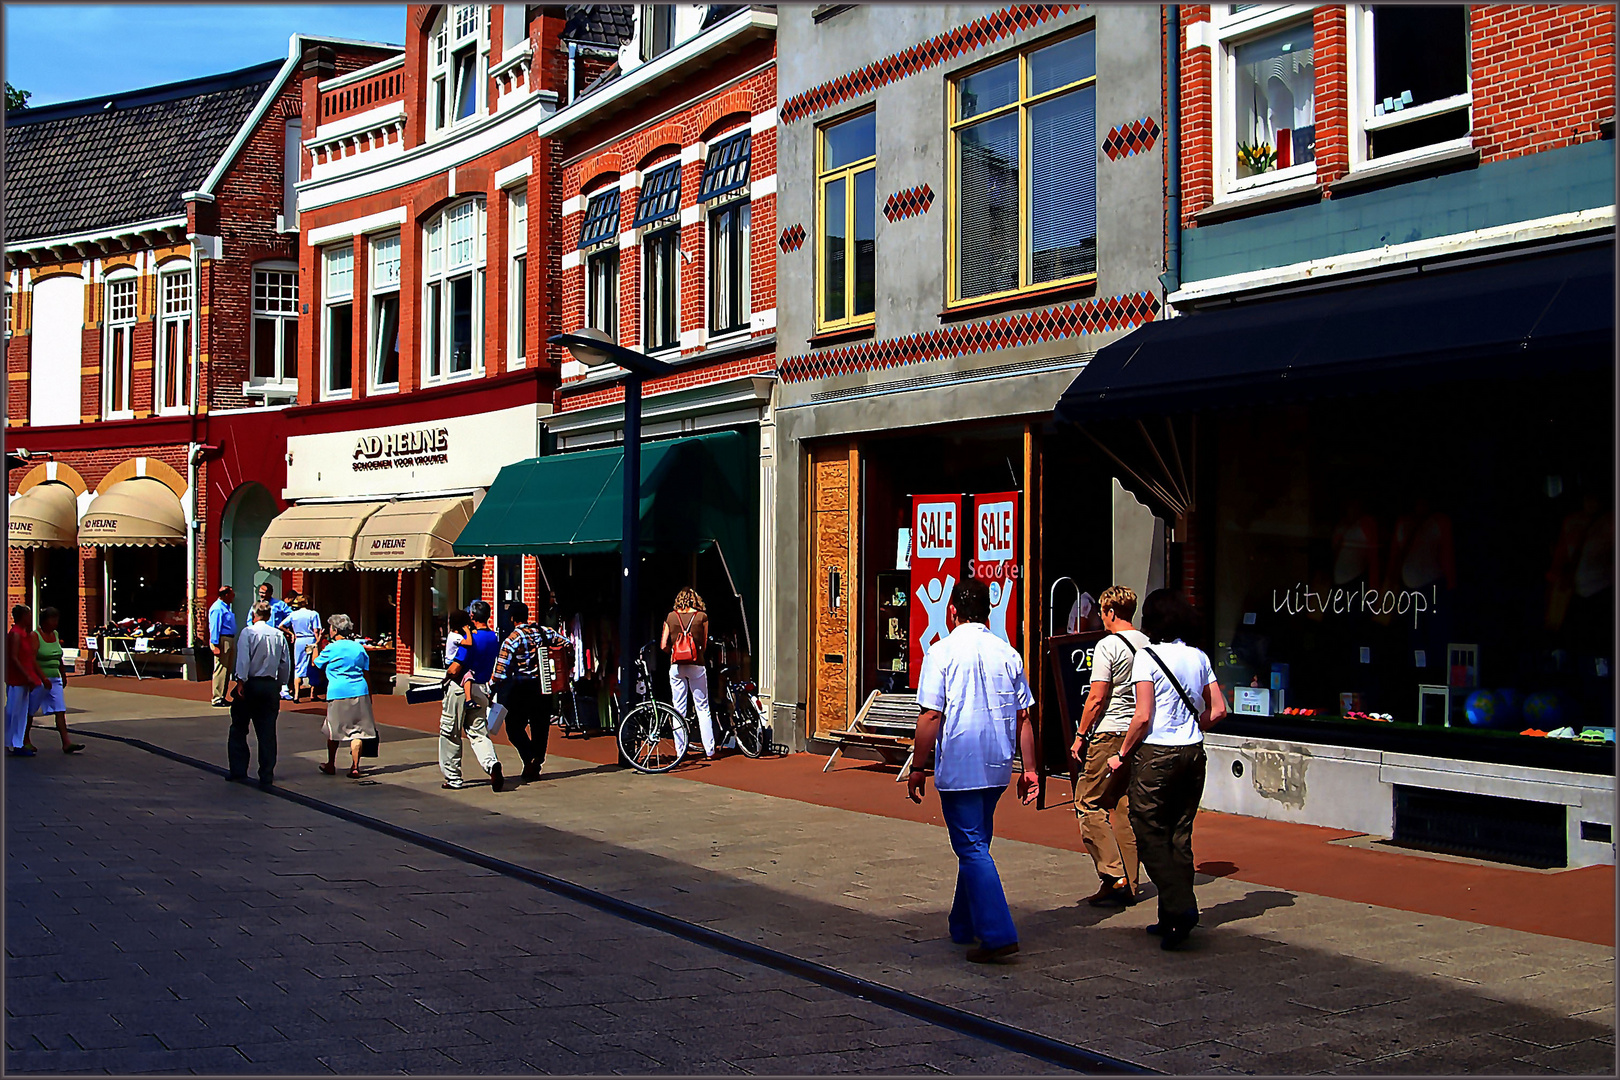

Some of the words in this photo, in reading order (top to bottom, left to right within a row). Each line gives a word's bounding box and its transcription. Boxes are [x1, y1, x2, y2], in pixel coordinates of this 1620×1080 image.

[353, 436, 383, 460] AD
[384, 427, 449, 457] HEIJNE
[352, 460, 393, 472] SCHOENEN
[393, 457, 414, 468] VOOR
[414, 454, 448, 466] VROUWEN
[9, 522, 34, 531] EIJNE
[92, 519, 118, 529] HEIJNE
[920, 511, 953, 549] SALE
[981, 510, 1011, 552] SALE
[281, 541, 293, 550] AD
[293, 541, 322, 550] HEIJNE
[371, 540, 381, 549] AD
[381, 539, 407, 549] HEIJNE
[1273, 582, 1437, 630] uitverkoop!
